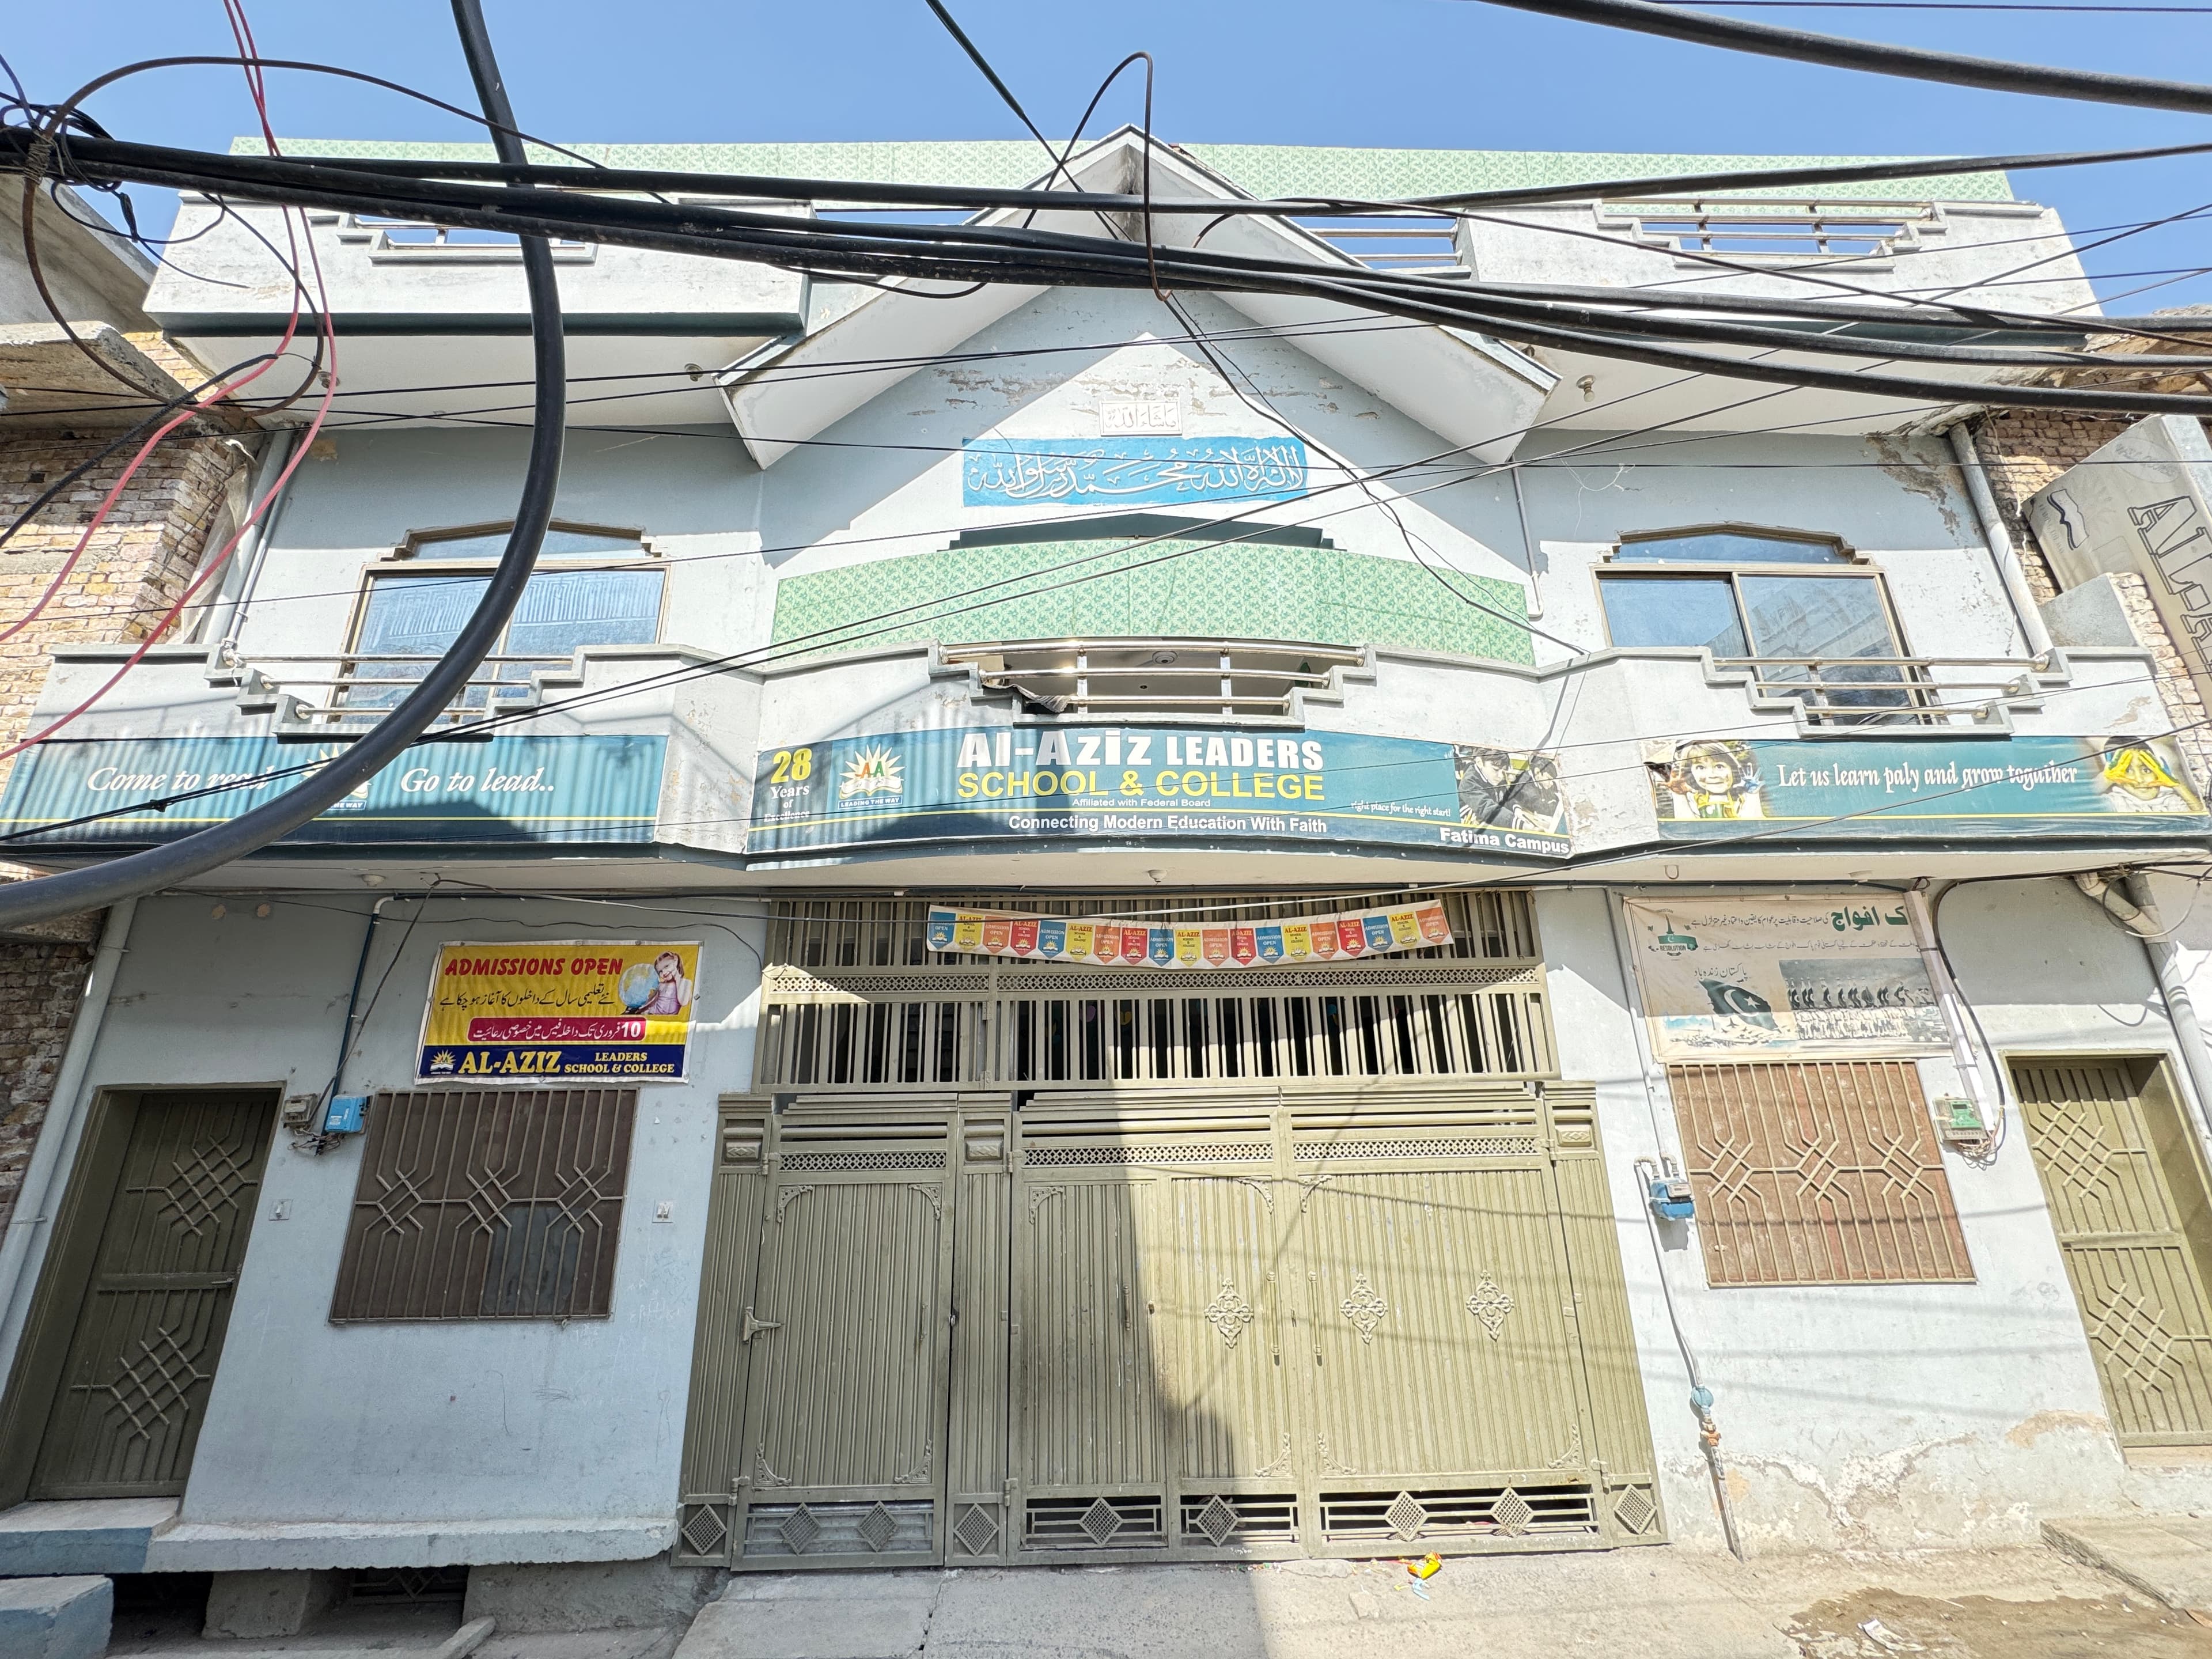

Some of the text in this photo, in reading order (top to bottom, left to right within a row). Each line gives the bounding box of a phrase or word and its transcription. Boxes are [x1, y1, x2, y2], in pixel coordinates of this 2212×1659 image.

[1166, 736, 1324, 771] LEADERS
[770, 748, 812, 784] 28
[87, 766, 276, 791] Come to read
[400, 767, 554, 792] Go to lead..
[957, 770, 1325, 801] SCHOOL & COLLEGE
[1776, 764, 1807, 787] Let
[1810, 770, 1830, 787] us
[1832, 762, 1881, 786] learn
[1883, 761, 1920, 793] paly
[1924, 761, 1959, 785] and
[1961, 767, 2004, 792] grow
[770, 785, 809, 800] Years
[783, 799, 793, 809] of
[840, 800, 869, 808] LEADING
[1072, 798, 1211, 807] Affiliated with Federal Board
[1389, 802, 1402, 815] for
[1402, 804, 1415, 813] the
[1415, 805, 1433, 817] right
[764, 810, 810, 823] Excellence
[1009, 815, 1327, 833] Connecting Modern Education With Faith
[1440, 827, 1570, 854] Fatima Campus
[1391, 914, 1414, 922] AL-AZIZ
[1831, 906, 1880, 931] افواج
[445, 958, 623, 976] ADMISSIONS OPEN
[440, 995, 455, 1012] ہے
[508, 988, 540, 1007] داخلوں
[539, 986, 556, 1005] کے
[556, 989, 578, 1007] سال
[621, 1021, 641, 1037] 10
[459, 1051, 562, 1074] AL-AZIZ
[594, 1052, 647, 1062] LEADERS
[564, 1063, 675, 1073] SCHOOL & COLLEGE
